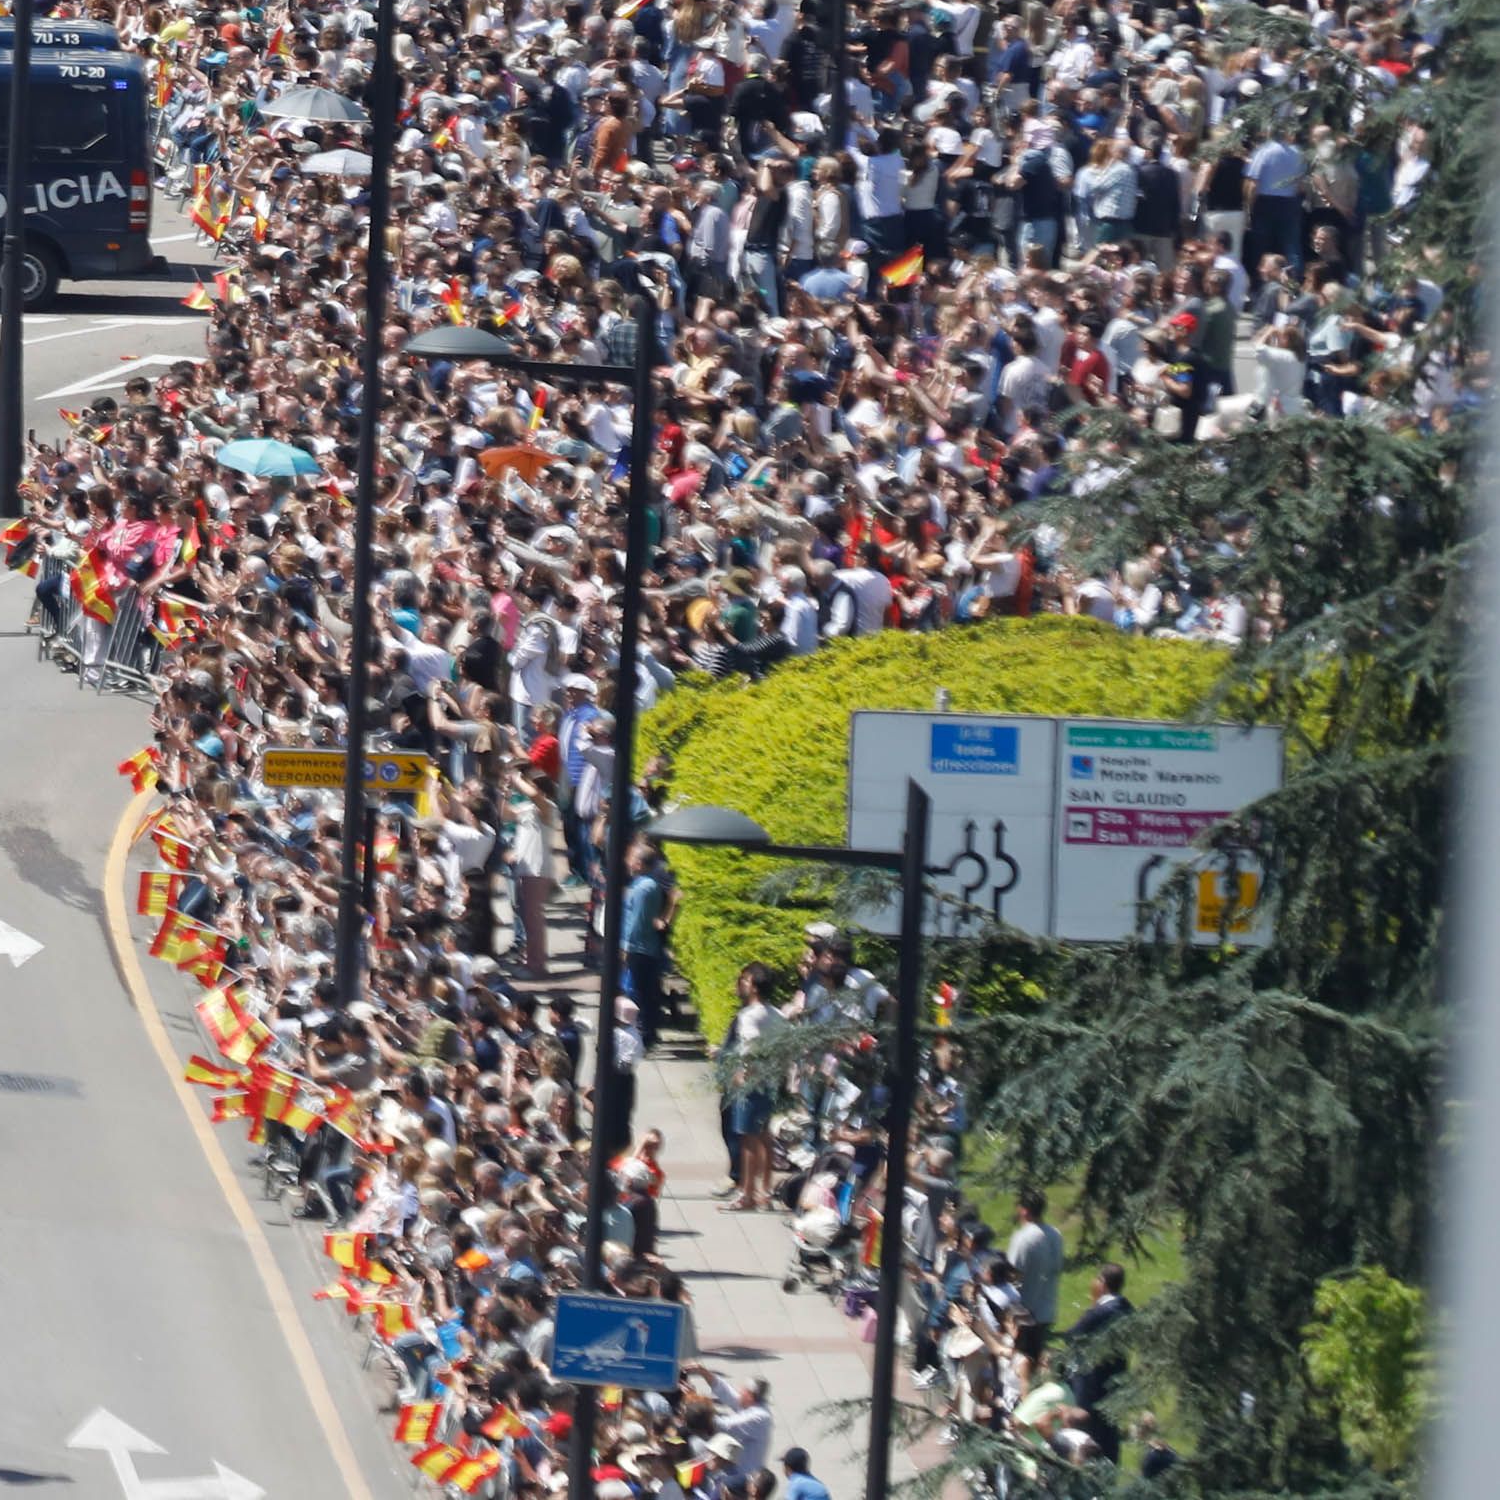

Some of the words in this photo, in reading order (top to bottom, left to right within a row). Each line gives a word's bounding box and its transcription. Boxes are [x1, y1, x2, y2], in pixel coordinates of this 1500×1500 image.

[33, 32, 80, 45] 7U-13
[59, 66, 106, 79] 7U-20
[265, 771, 346, 783] MERCADON
[1099, 769, 1148, 783] Monte
[1069, 789, 1106, 803] SAN
[1112, 791, 1186, 806] CLAUDIO
[1096, 830, 1129, 843] San
